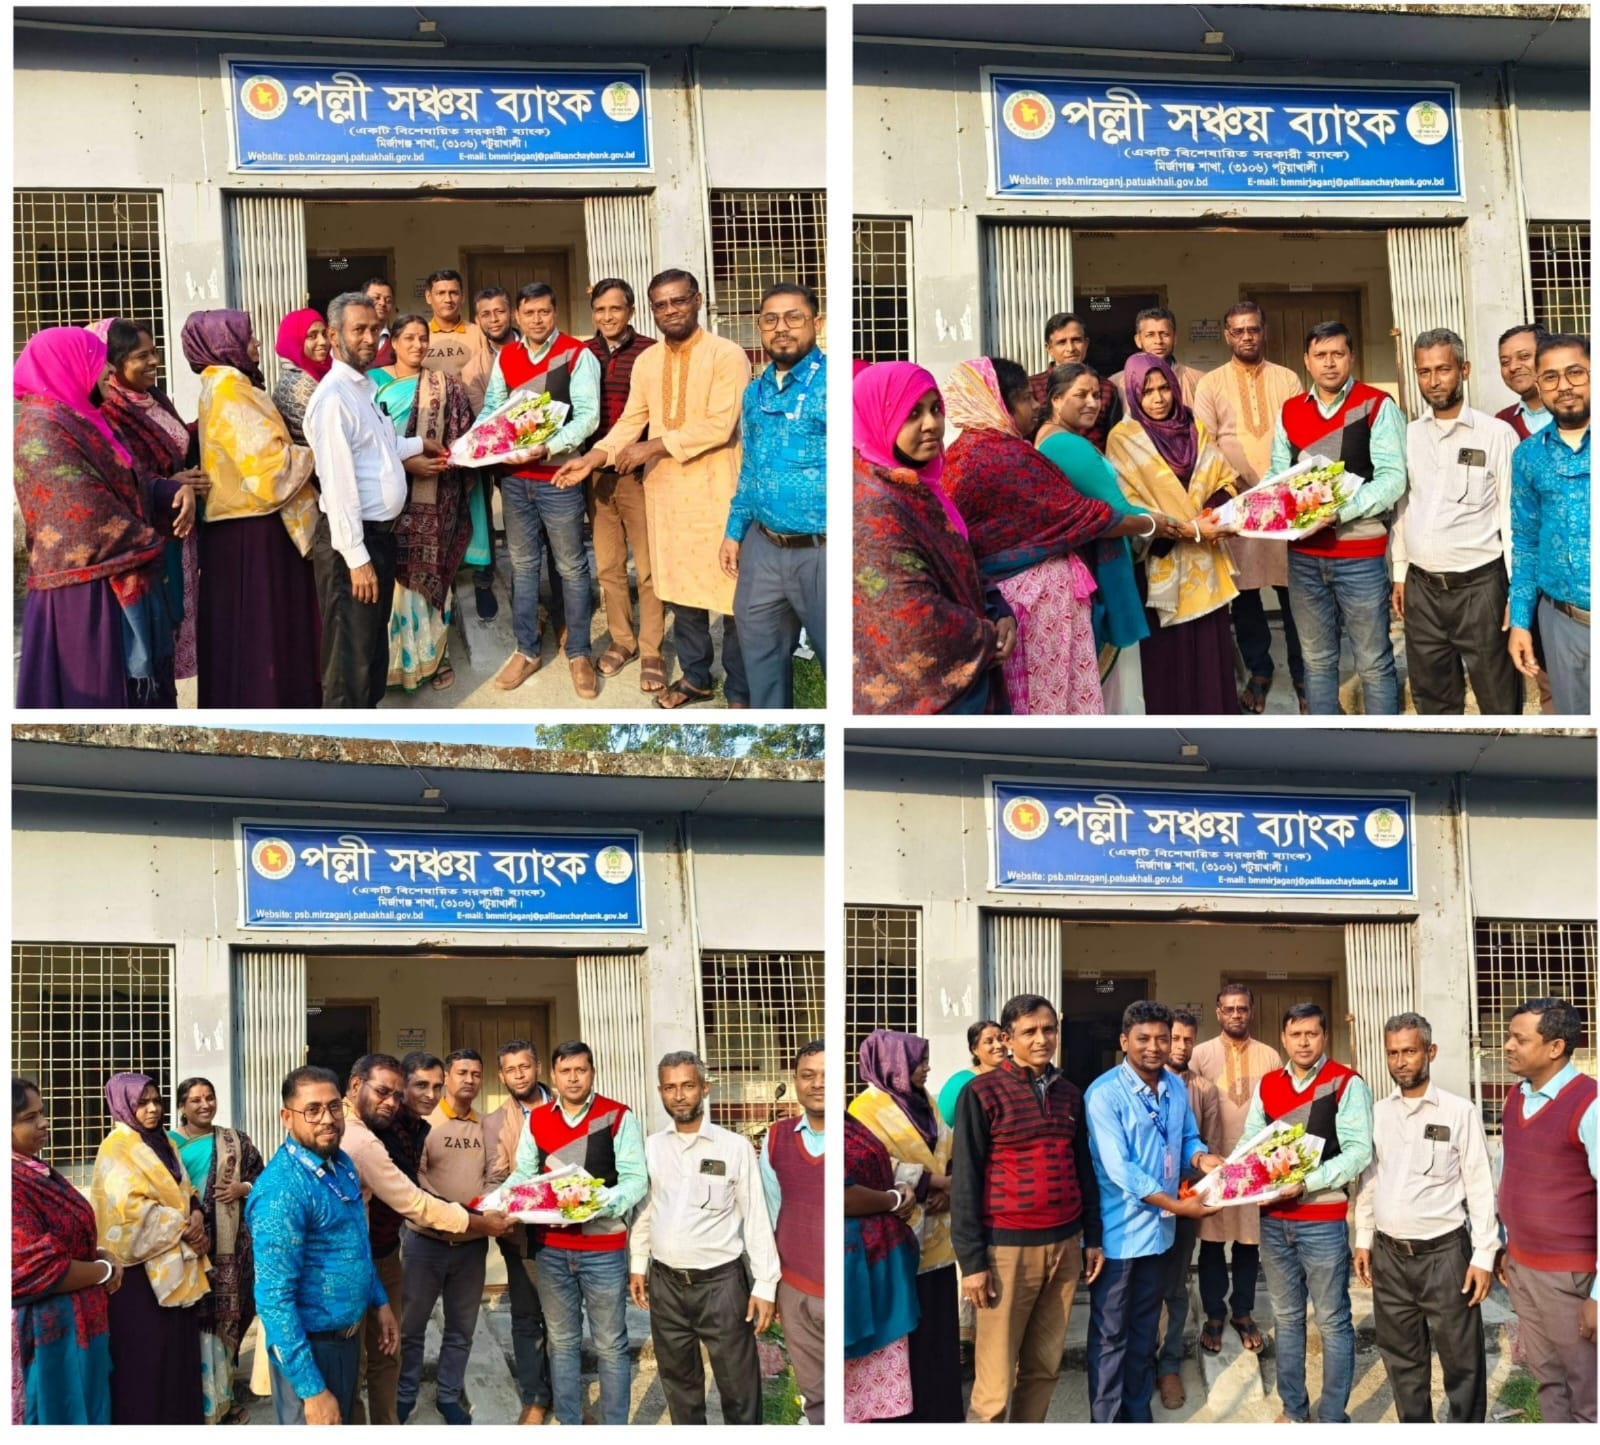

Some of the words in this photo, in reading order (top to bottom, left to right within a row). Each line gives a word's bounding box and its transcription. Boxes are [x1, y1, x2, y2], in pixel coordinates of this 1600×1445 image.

[293, 72, 373, 124] পল্লী
[382, 86, 482, 123] সঞ্চয়
[491, 86, 595, 125] ব্যাংক
[1061, 87, 1152, 145] পল্লী
[1161, 102, 1275, 145] সঞ্চয়
[1284, 103, 1399, 148] ব্যাংক
[247, 152, 287, 161] Website:
[459, 153, 487, 161] E-mail:
[1228, 162, 1268, 174] (৩১০৬)
[1009, 174, 1053, 185] Website:
[1055, 176, 1208, 188] psb.mirzaganj.patuakhali.gov.bd
[1247, 177, 1279, 186] E-mail:
[427, 347, 465, 358] ZARA
[1054, 793, 1134, 846] পল্লী
[1143, 807, 1245, 846] সঞ্চয়
[1253, 809, 1359, 850] ব্যাংক
[300, 835, 376, 884] পল্লী
[385, 847, 482, 883] সঞ্চয়
[490, 848, 589, 887] ব্যাংক
[1202, 862, 1237, 873] (৩১০৬)
[1007, 870, 1046, 881] Website:
[1047, 872, 1183, 884] psb.mirzaganj.patuakhali.gov.bd
[1218, 875, 1246, 884] E-mail:
[255, 909, 292, 919] Website:
[456, 912, 483, 920] E-mail:
[444, 1136, 481, 1149] ZARA
